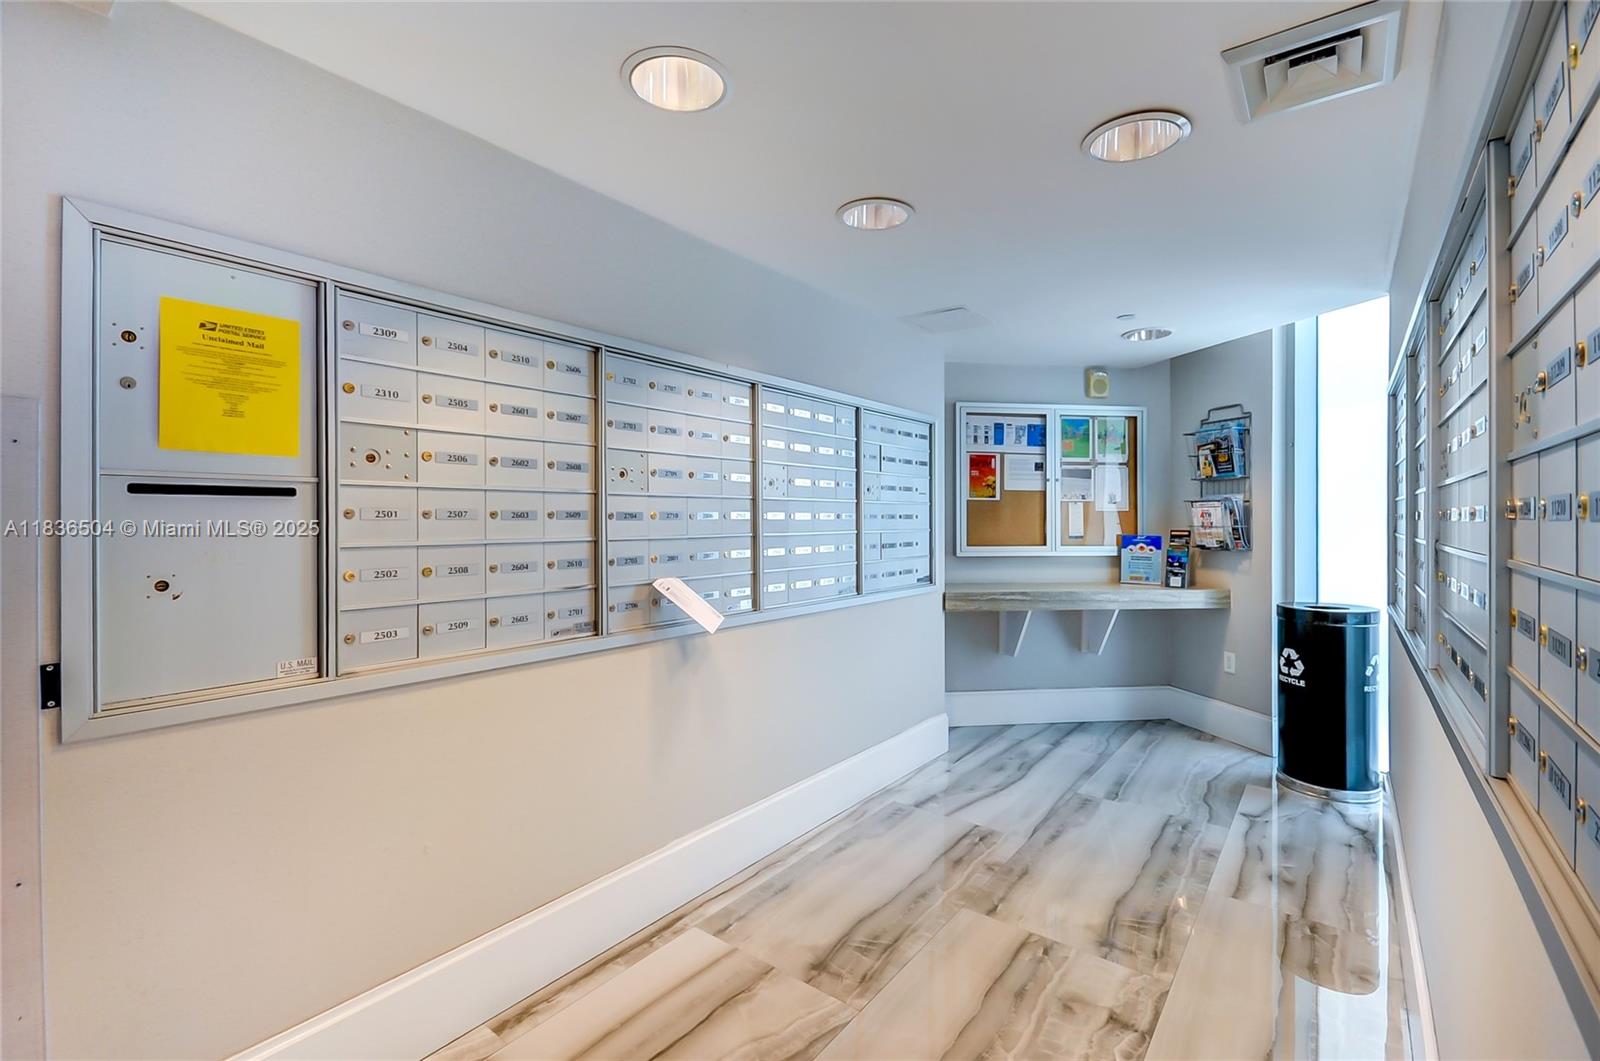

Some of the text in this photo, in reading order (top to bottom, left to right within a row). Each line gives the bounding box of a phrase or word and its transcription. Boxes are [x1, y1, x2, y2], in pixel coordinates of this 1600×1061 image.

[372, 326, 398, 340] 2309
[202, 333, 265, 350] Unclaimed Mail
[447, 341, 469, 353] 2504
[511, 354, 531, 365] 2510
[565, 364, 582, 374] 2606
[374, 388, 399, 400] 2310
[447, 398, 469, 408] 2505
[511, 406, 530, 416] 2601
[565, 413, 581, 422] 2607
[447, 454, 468, 463] 2506
[511, 459, 530, 468] 2602
[374, 510, 398, 519] 2501
[447, 510, 468, 519] 2507
[511, 511, 529, 520] 2603
[565, 511, 582, 520] 2609
[511, 563, 529, 572] 2604
[566, 559, 583, 568] 2610
[374, 569, 398, 579] 2502
[447, 566, 469, 575] 2508
[567, 608, 583, 617] 2701
[511, 614, 529, 624] 2605
[447, 621, 469, 631] 2509
[374, 630, 398, 640] 2503
[280, 659, 314, 669] U.S. MAIL
[1279, 674, 1306, 687] RECYCLE
